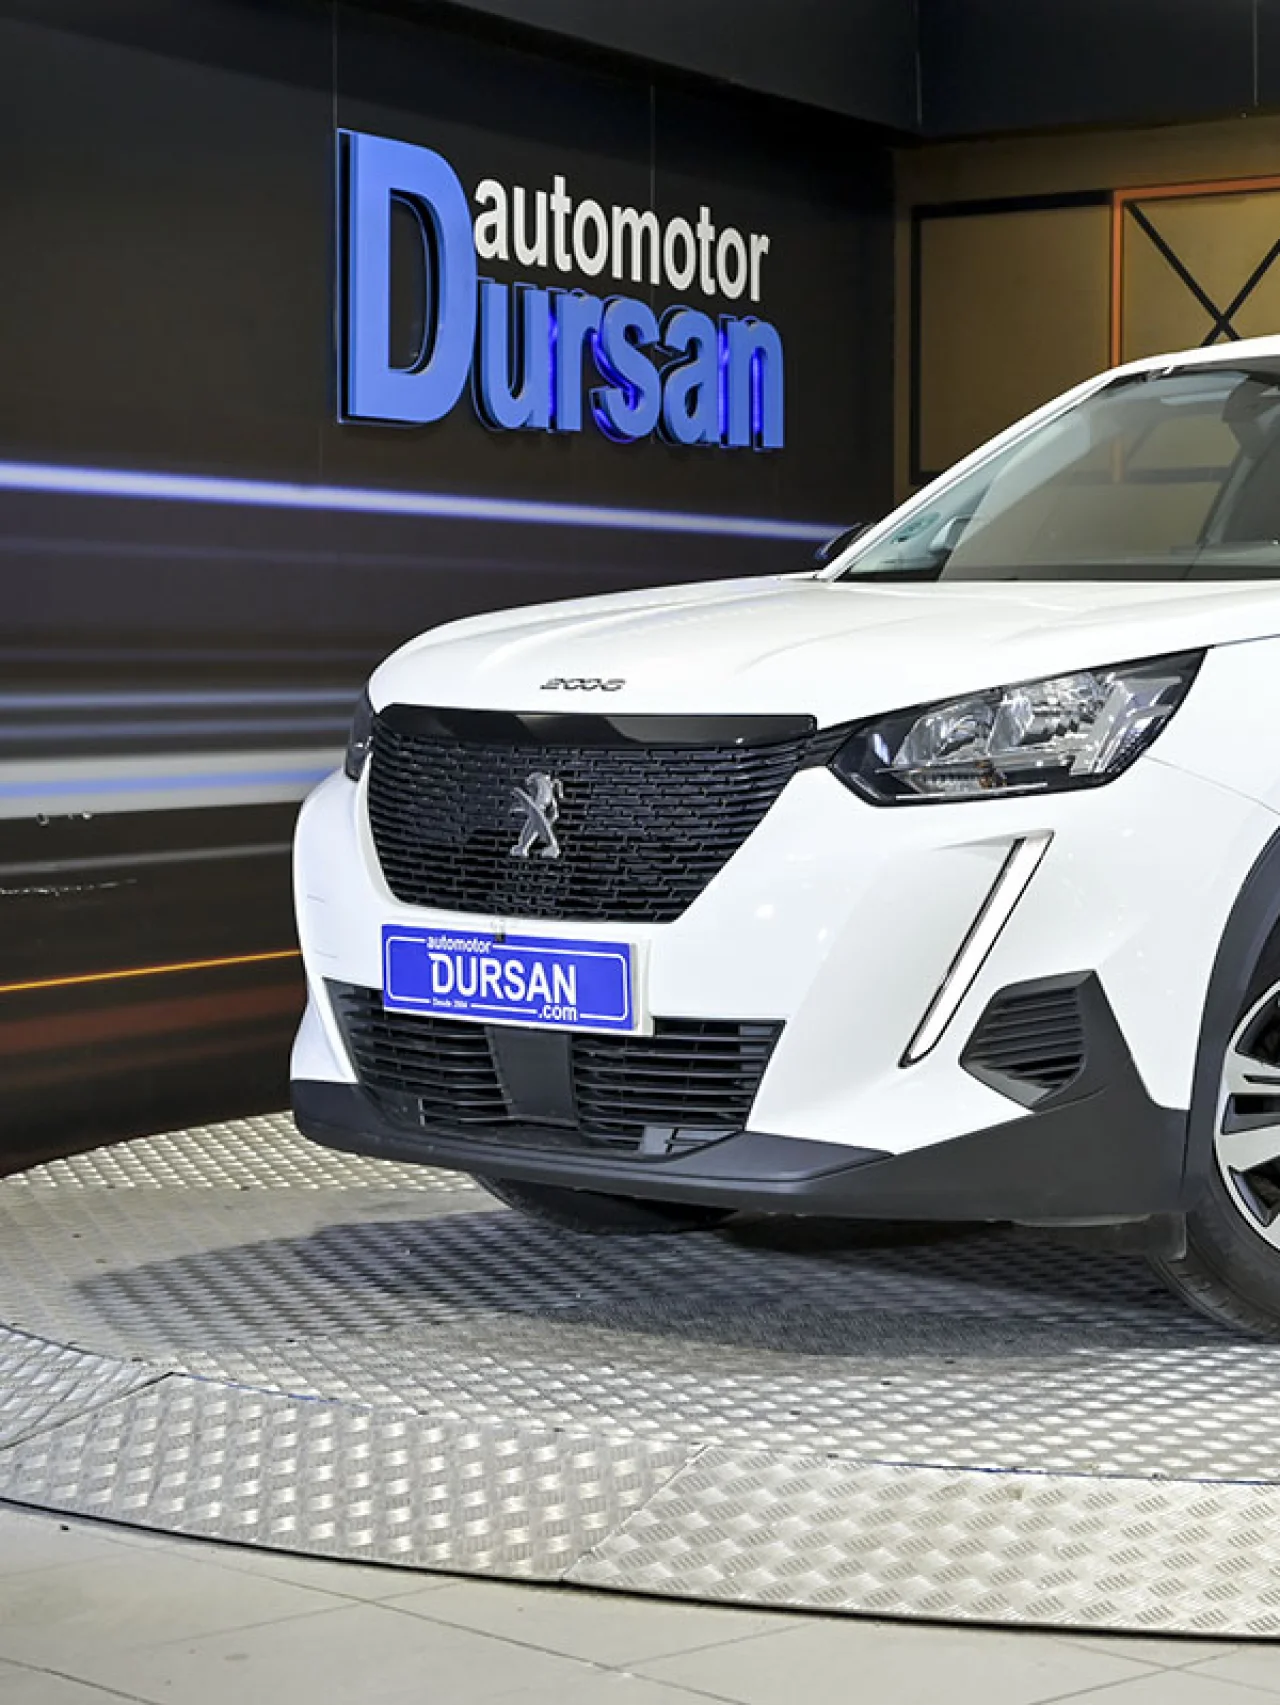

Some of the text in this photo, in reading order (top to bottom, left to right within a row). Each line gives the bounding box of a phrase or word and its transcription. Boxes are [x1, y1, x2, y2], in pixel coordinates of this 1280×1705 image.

[474, 175, 770, 301] automotor
[337, 127, 786, 451] Dursan
[426, 934, 492, 954] automotor
[428, 952, 577, 1006] DURSAN
[538, 1003, 578, 1022] .com
